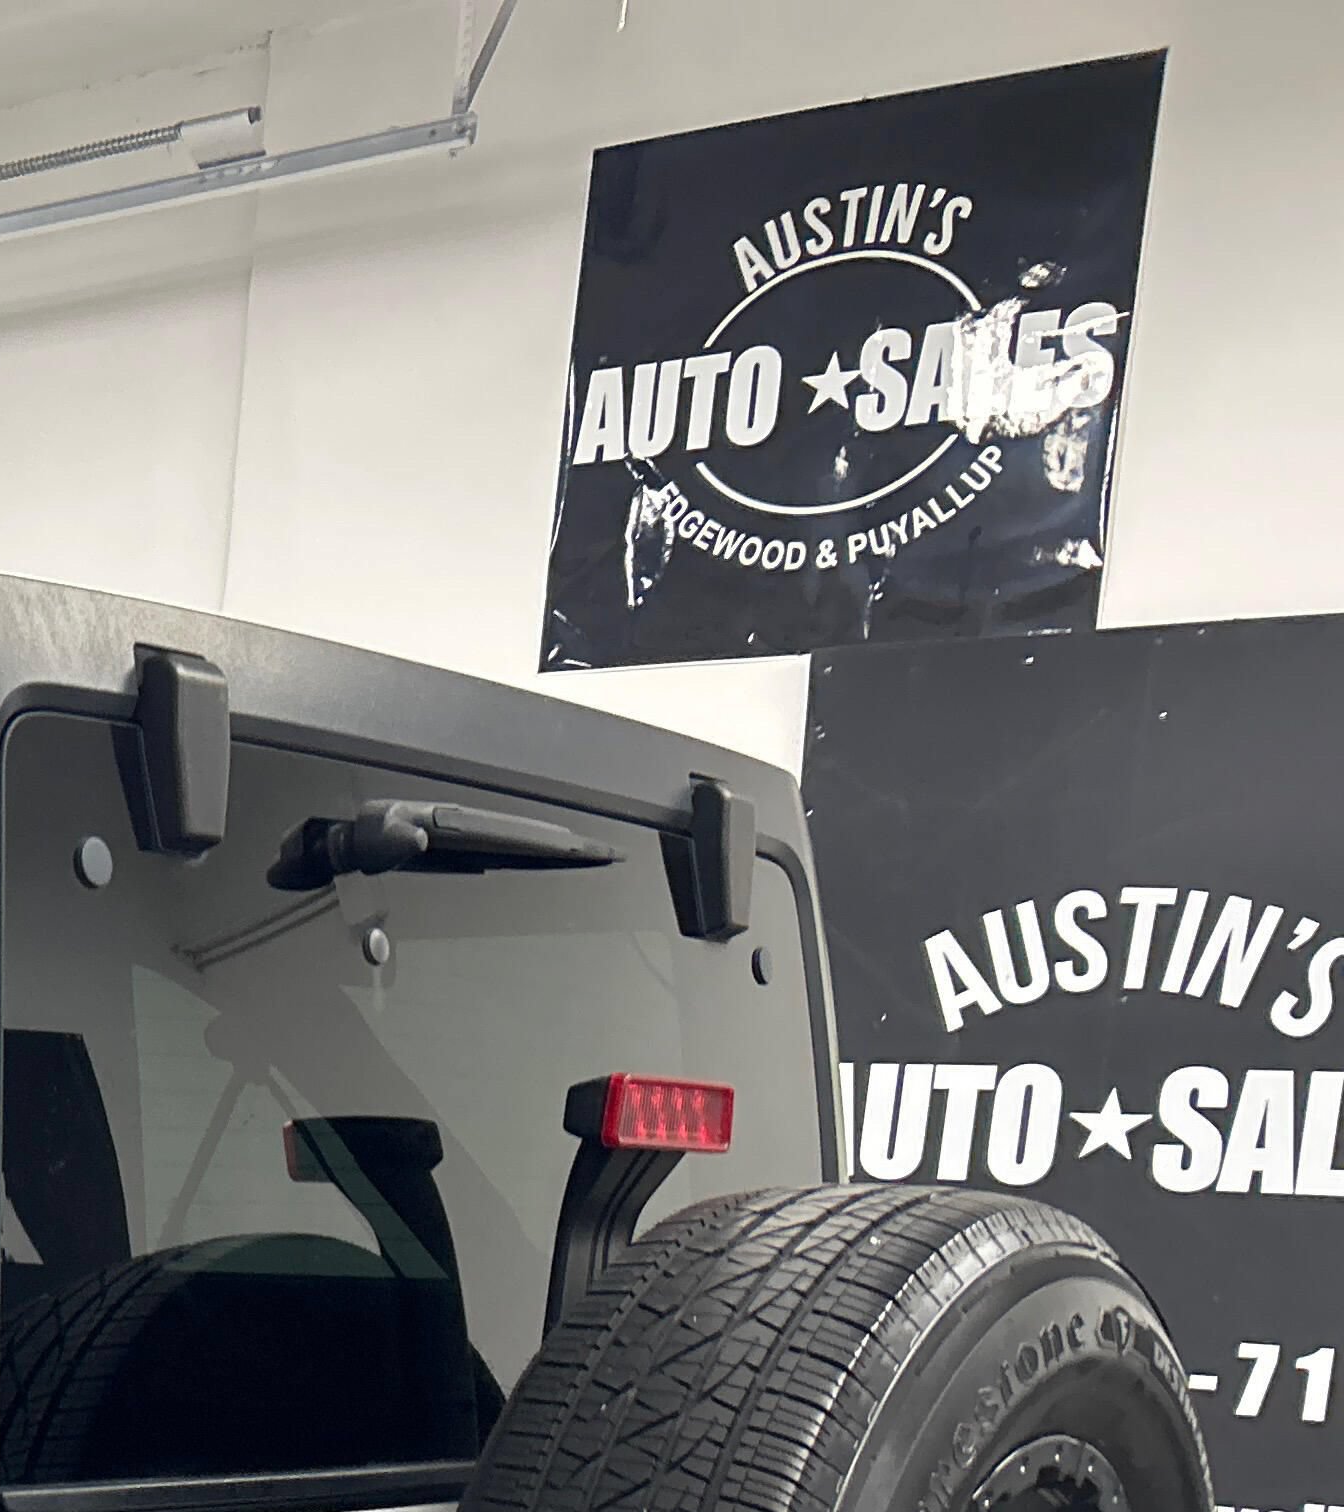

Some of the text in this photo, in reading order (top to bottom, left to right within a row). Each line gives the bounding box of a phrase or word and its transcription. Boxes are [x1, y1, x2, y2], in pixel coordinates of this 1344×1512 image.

[732, 183, 973, 293] AUSTIN'S
[572, 301, 1118, 466] AUTO SALES
[654, 444, 1006, 571] EDGEWOOD & PUYALLUP
[924, 886, 1344, 1039] AUSTIN'S
